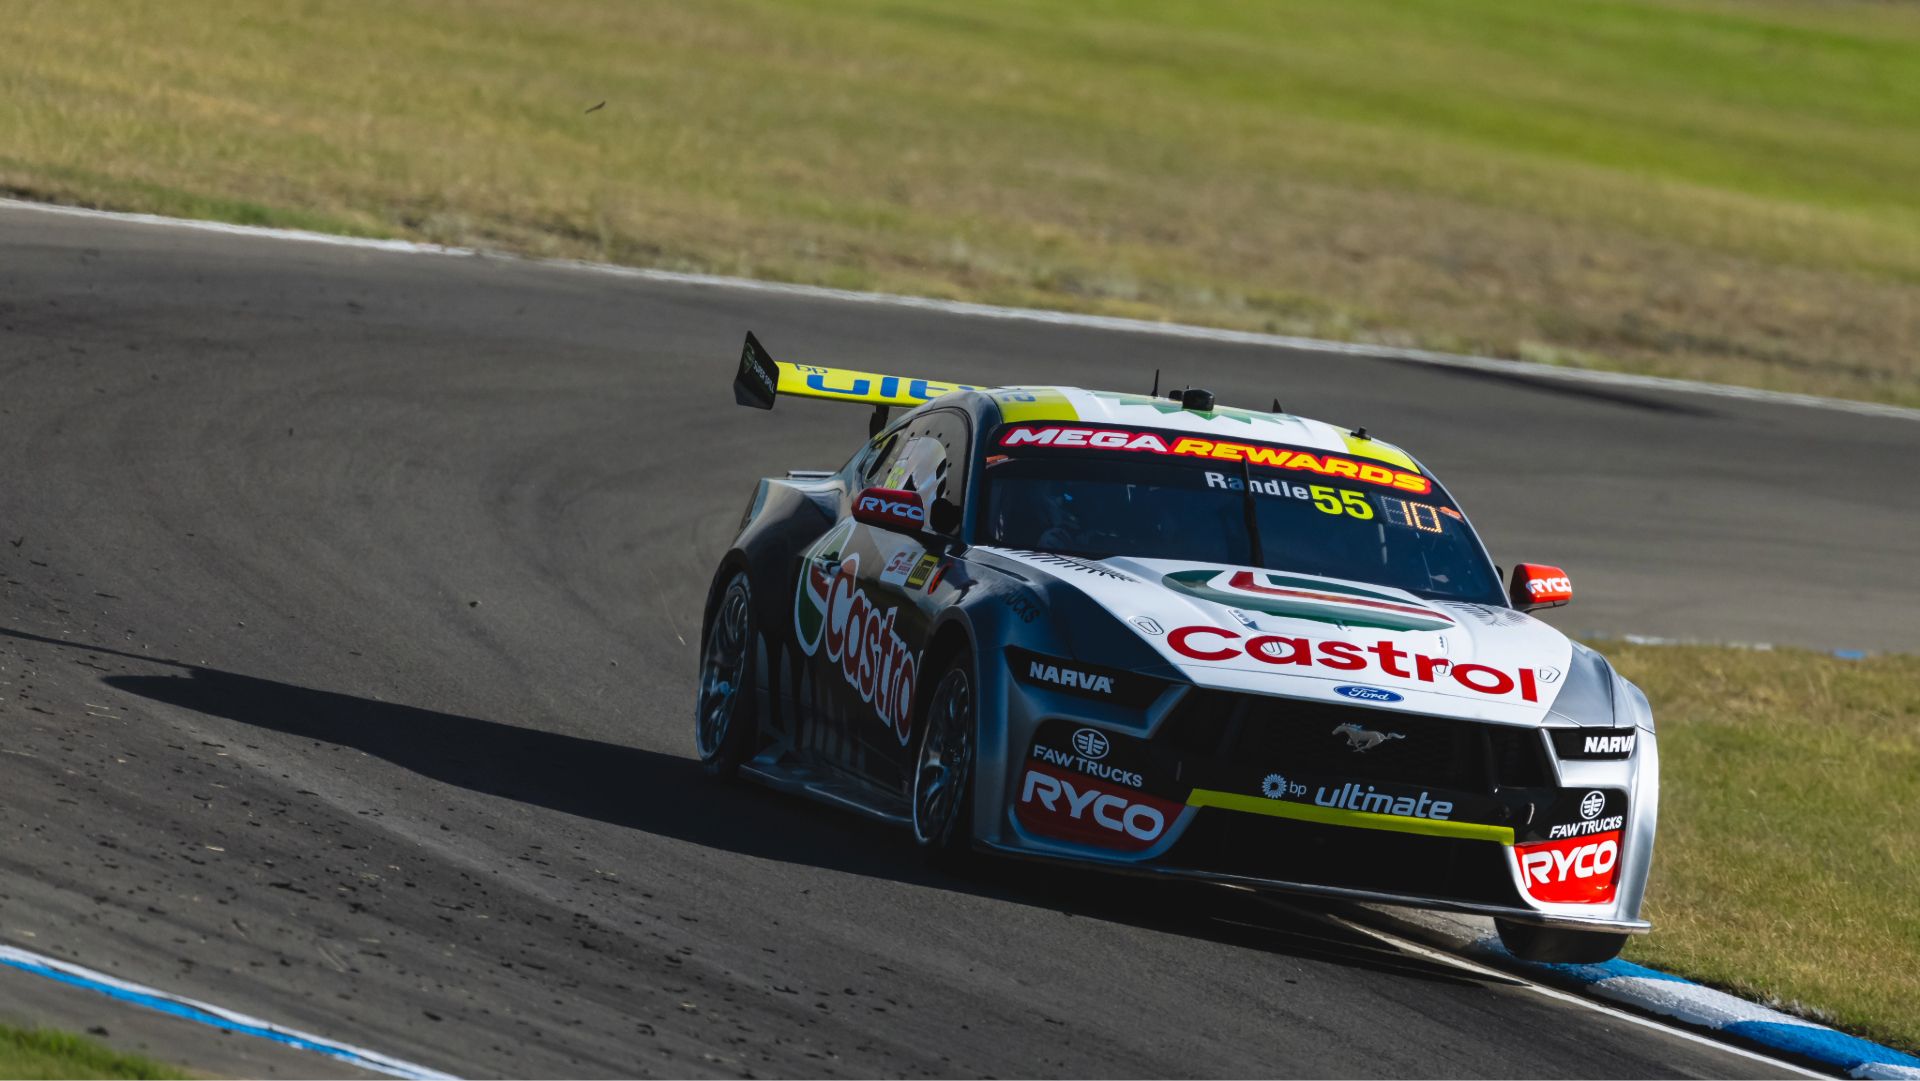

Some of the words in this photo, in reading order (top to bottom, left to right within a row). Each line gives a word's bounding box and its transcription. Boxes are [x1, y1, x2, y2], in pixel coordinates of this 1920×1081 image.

[795, 363, 828, 374] bp
[806, 375, 974, 400] ult
[1004, 428, 1168, 453] MEGA
[1171, 438, 1428, 493] REWARDS
[859, 496, 925, 521] RYCO
[1204, 471, 1309, 500] Randle
[1309, 484, 1374, 520] 55
[825, 553, 919, 746] Castro
[1166, 625, 1538, 703] Castrol
[1029, 661, 1112, 694] NARVA
[1348, 686, 1390, 701] Ford
[1033, 743, 1074, 768] FAW
[1075, 757, 1144, 788] TRUCKS
[1021, 769, 1164, 841] RYCO
[1289, 781, 1307, 797] bp
[1314, 782, 1453, 821] ultimate
[1549, 821, 1582, 839] FAW
[1580, 815, 1623, 835] TRUCKS
[1522, 839, 1618, 889] RYCO
